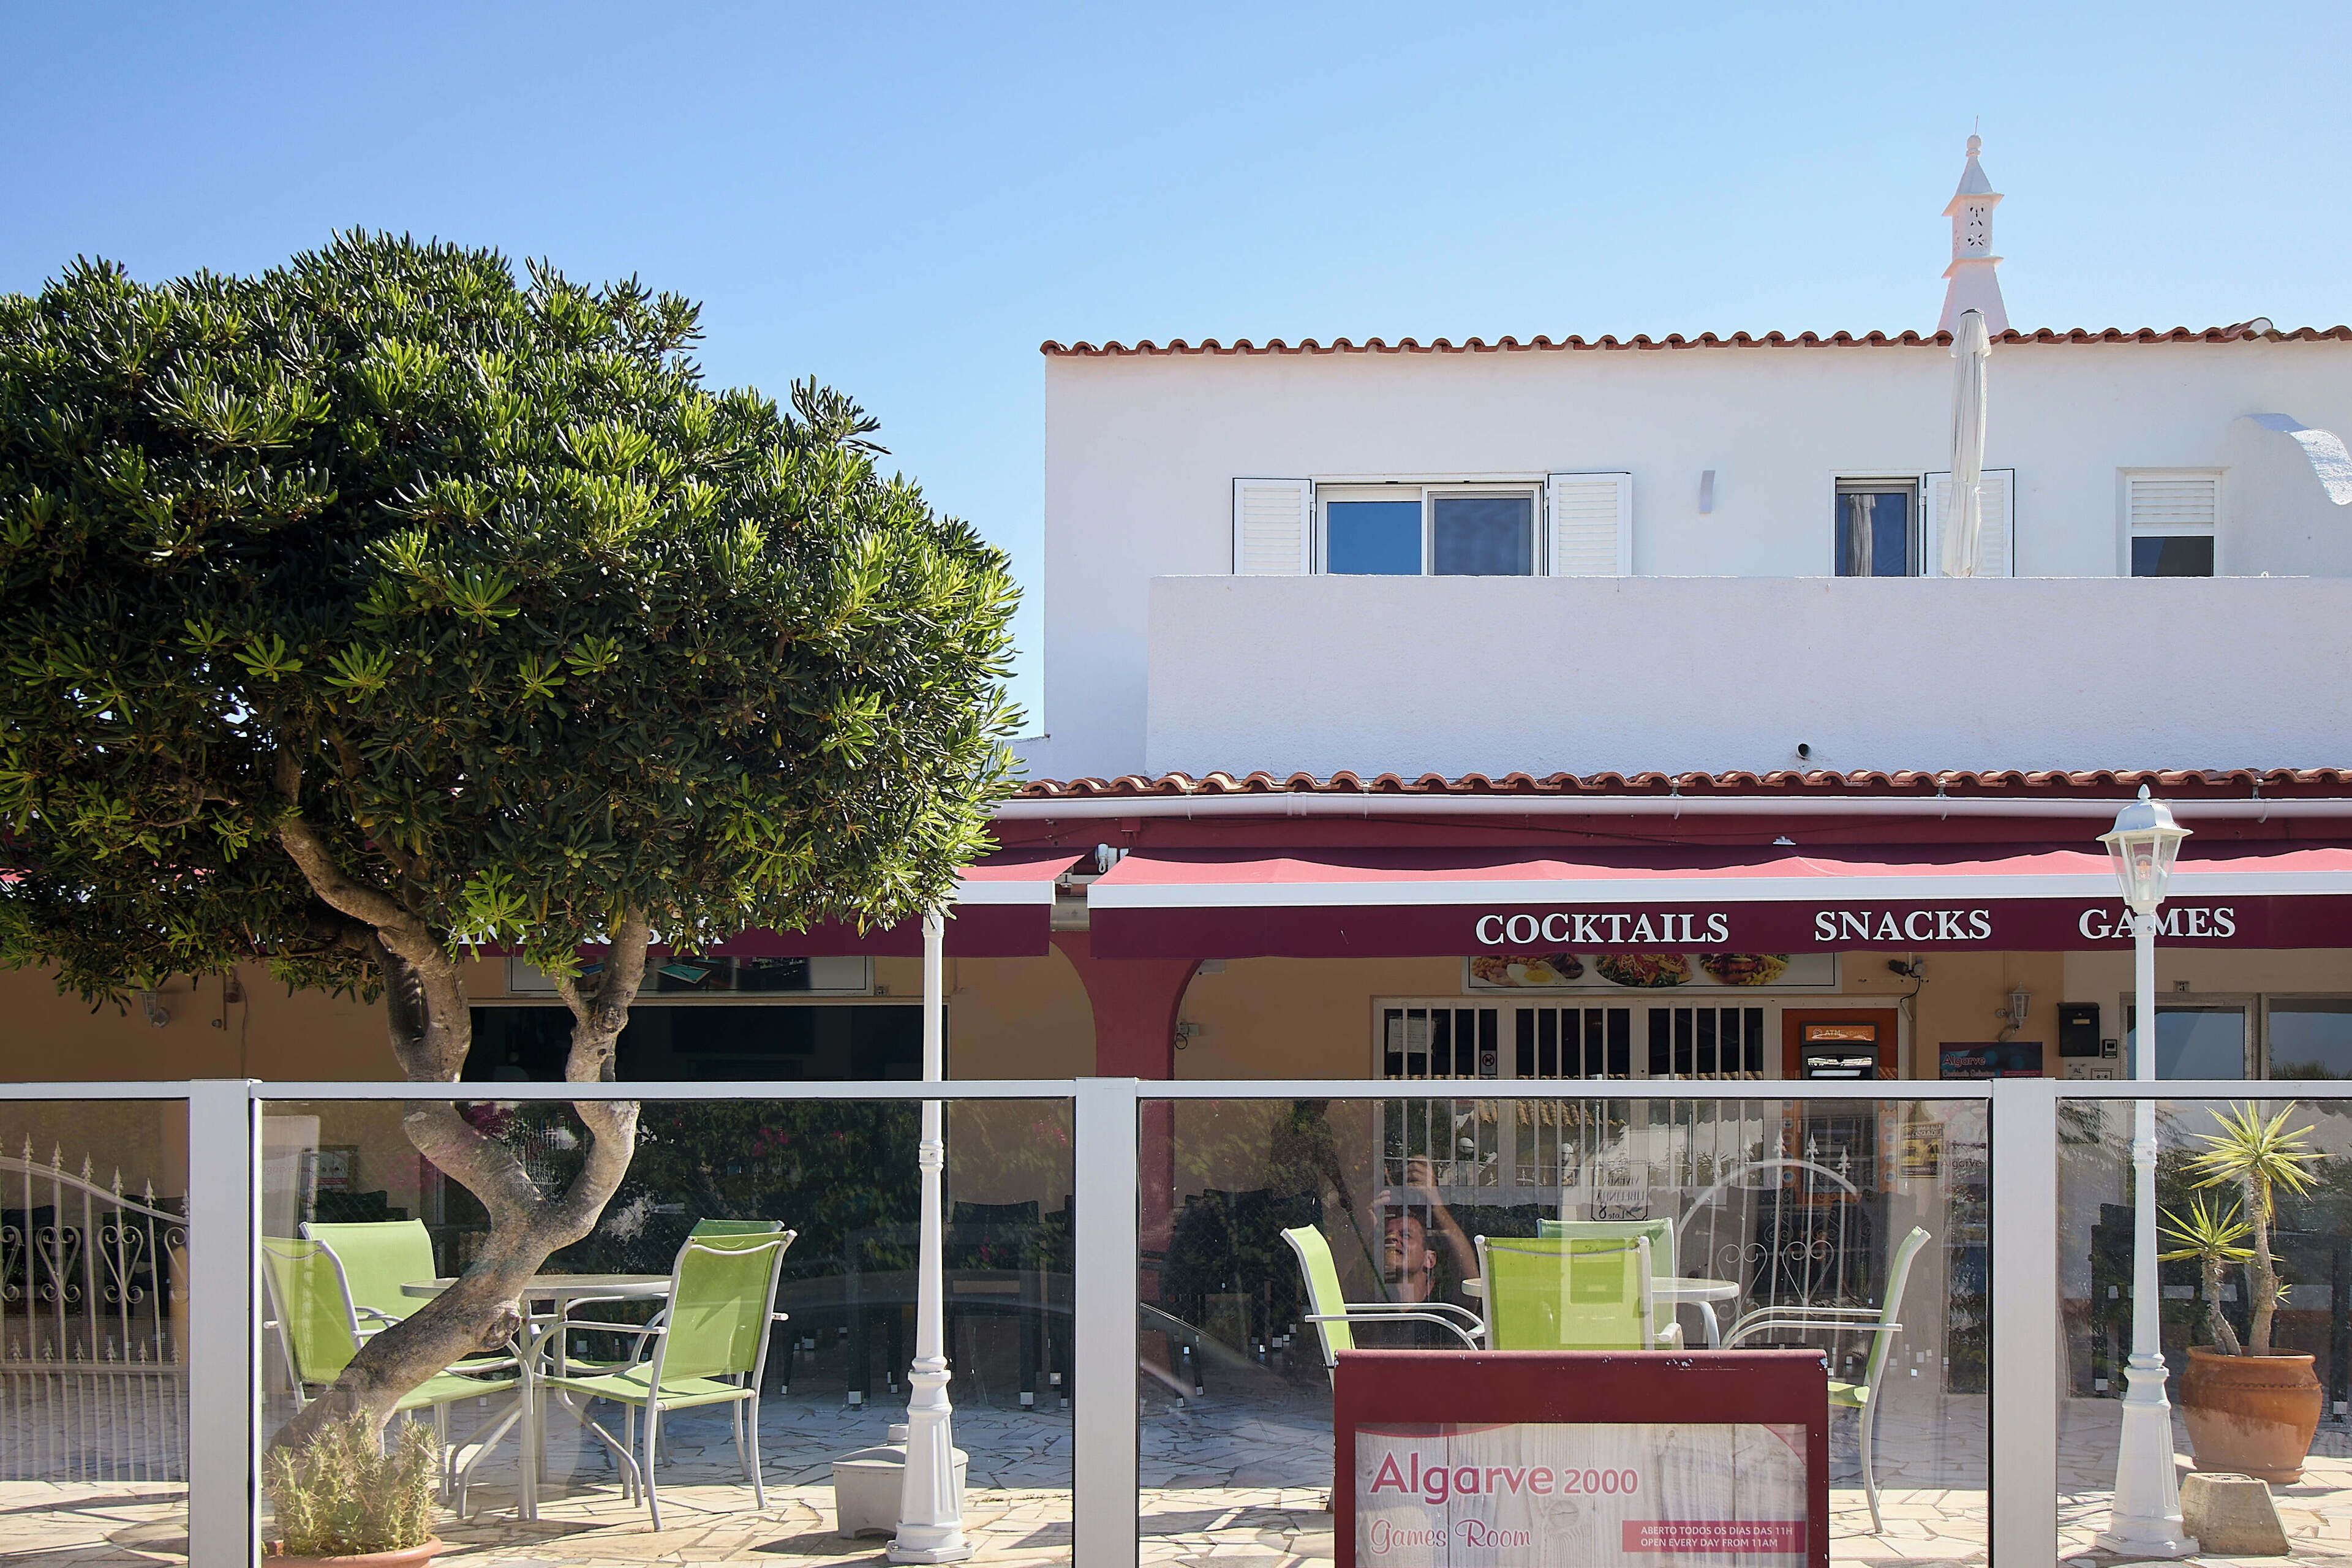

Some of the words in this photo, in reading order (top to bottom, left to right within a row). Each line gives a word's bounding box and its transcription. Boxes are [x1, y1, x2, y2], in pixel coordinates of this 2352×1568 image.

[1476, 913, 1730, 945] COCKTAILS
[1814, 910, 1992, 941] SNACKS
[2078, 907, 2236, 940] GAMES
[1943, 1054, 1986, 1067] Algarve
[1940, 1157, 1982, 1170] Algarve
[1370, 1452, 1554, 1505] Algarve
[1564, 1469, 1638, 1494] 2000
[1370, 1518, 1447, 1555] Games
[1454, 1518, 1531, 1548] Room
[1641, 1526, 1677, 1535] ABERTO
[1679, 1526, 1712, 1535] TODOS
[1714, 1526, 1727, 1535] OS
[1729, 1526, 1751, 1536] DIAS
[1753, 1526, 1773, 1536] DAS
[1775, 1526, 1793, 1536] 11H
[1641, 1538, 1667, 1547] OPEN
[1668, 1538, 1698, 1547] EVERY
[1700, 1538, 1720, 1547] DAY
[1722, 1538, 1749, 1547] FROM
[1751, 1538, 1778, 1547] 11AM
